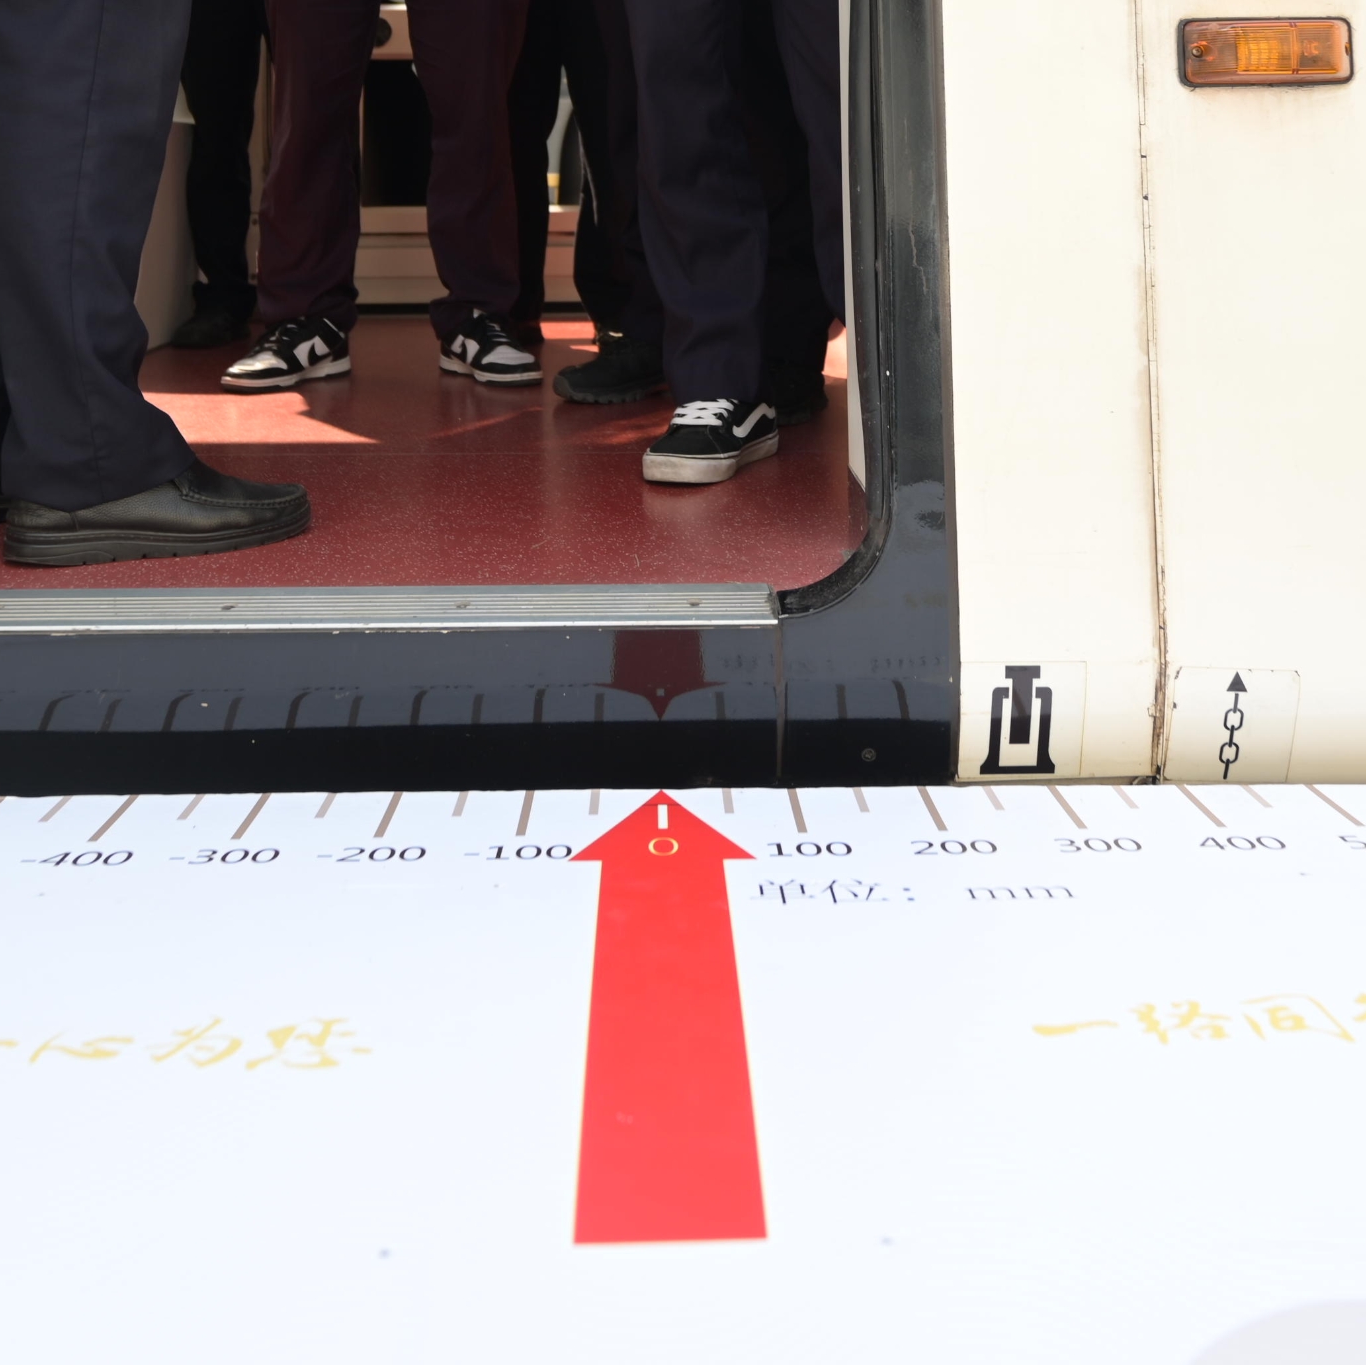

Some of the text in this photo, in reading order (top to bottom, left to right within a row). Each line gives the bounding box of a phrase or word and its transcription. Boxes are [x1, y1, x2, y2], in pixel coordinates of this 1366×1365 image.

[20, 849, 135, 868] -400
[169, 847, 281, 865] -300
[317, 845, 427, 863] -200
[463, 844, 574, 862] -100
[647, 837, 679, 856] 0
[767, 841, 853, 857] 100
[910, 839, 998, 856] 200
[1053, 837, 1143, 853] 300
[1198, 835, 1287, 851] 400
[966, 886, 1074, 901] mm
